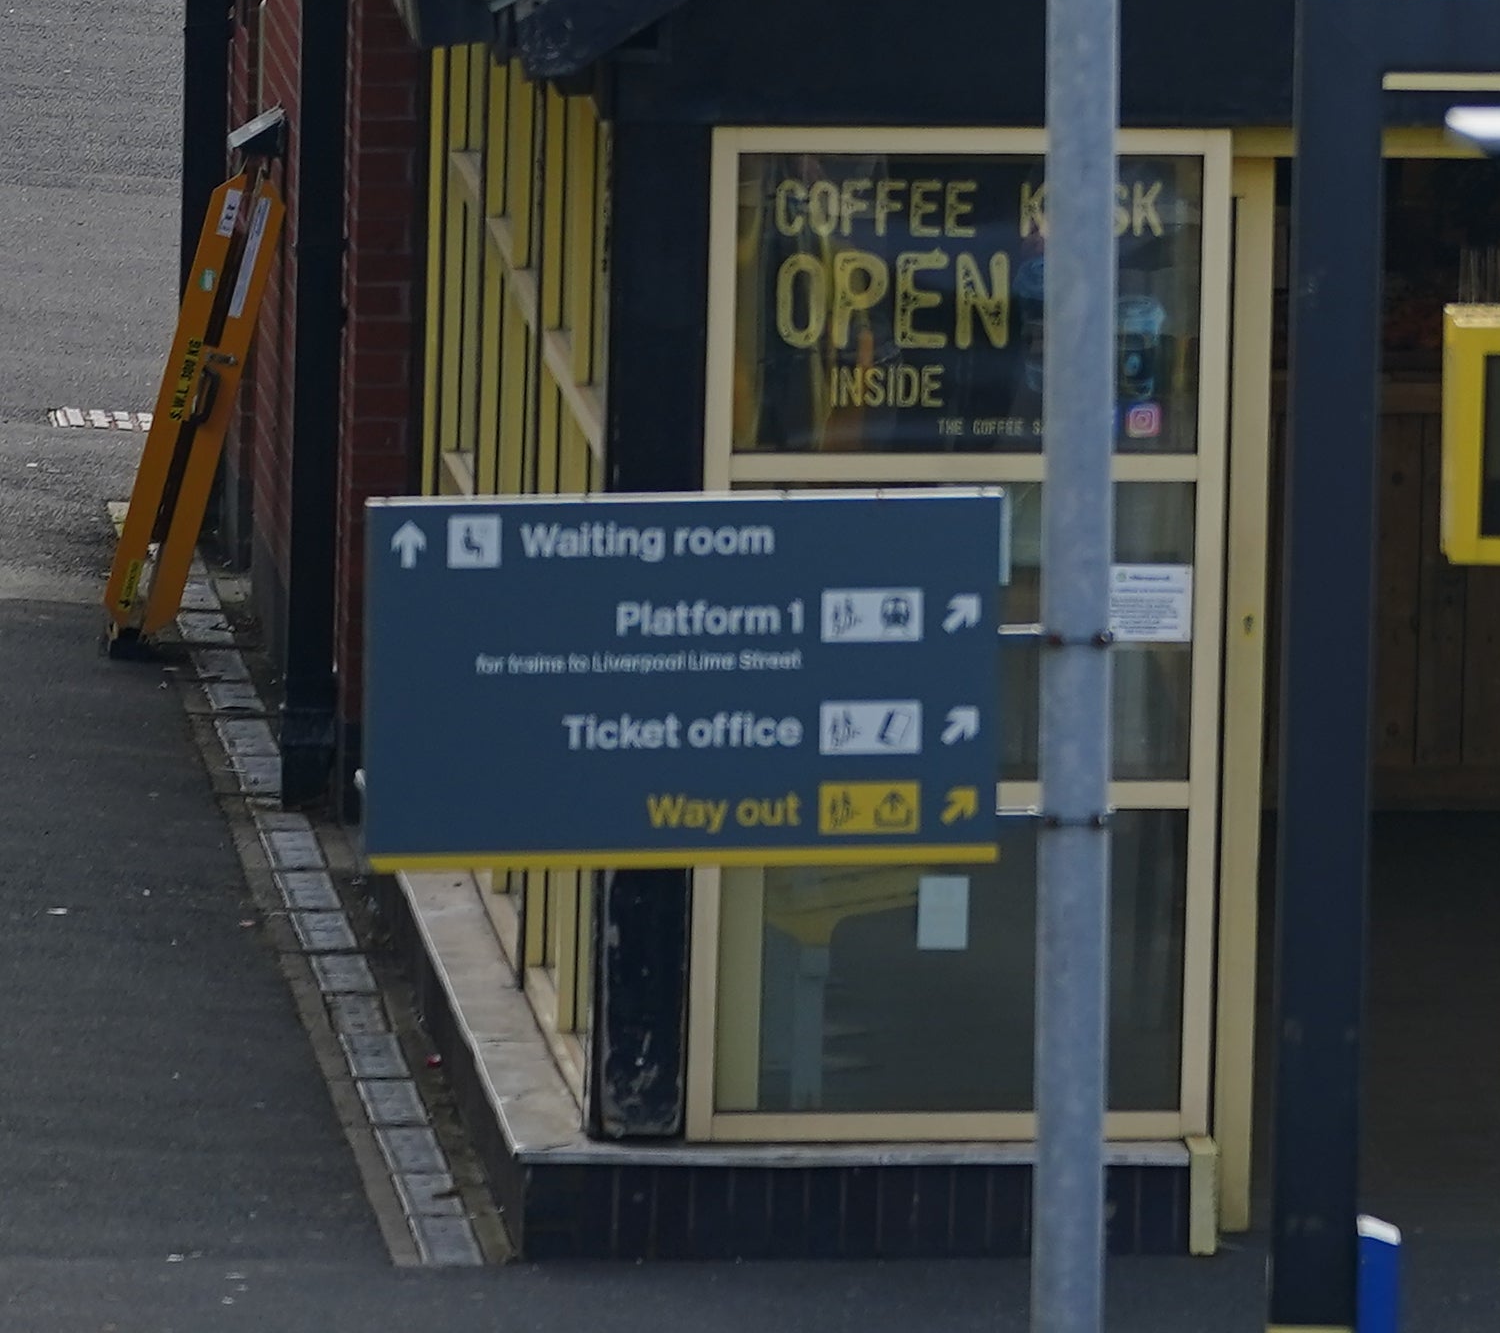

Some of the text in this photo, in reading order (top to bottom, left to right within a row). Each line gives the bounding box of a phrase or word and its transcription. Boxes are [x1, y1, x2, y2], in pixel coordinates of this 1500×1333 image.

[775, 179, 1164, 238] COFFEE KSK
[775, 246, 1011, 349] OPEN
[829, 363, 946, 409] INSIDE
[937, 417, 963, 436] THE
[973, 416, 1025, 437] COFFEE
[520, 524, 775, 562] Waiting room
[615, 598, 805, 636] Platform 1
[475, 646, 803, 674] for trains to Liverpool Lime Street
[561, 711, 804, 751] Ticket office
[647, 792, 801, 835] Way out
